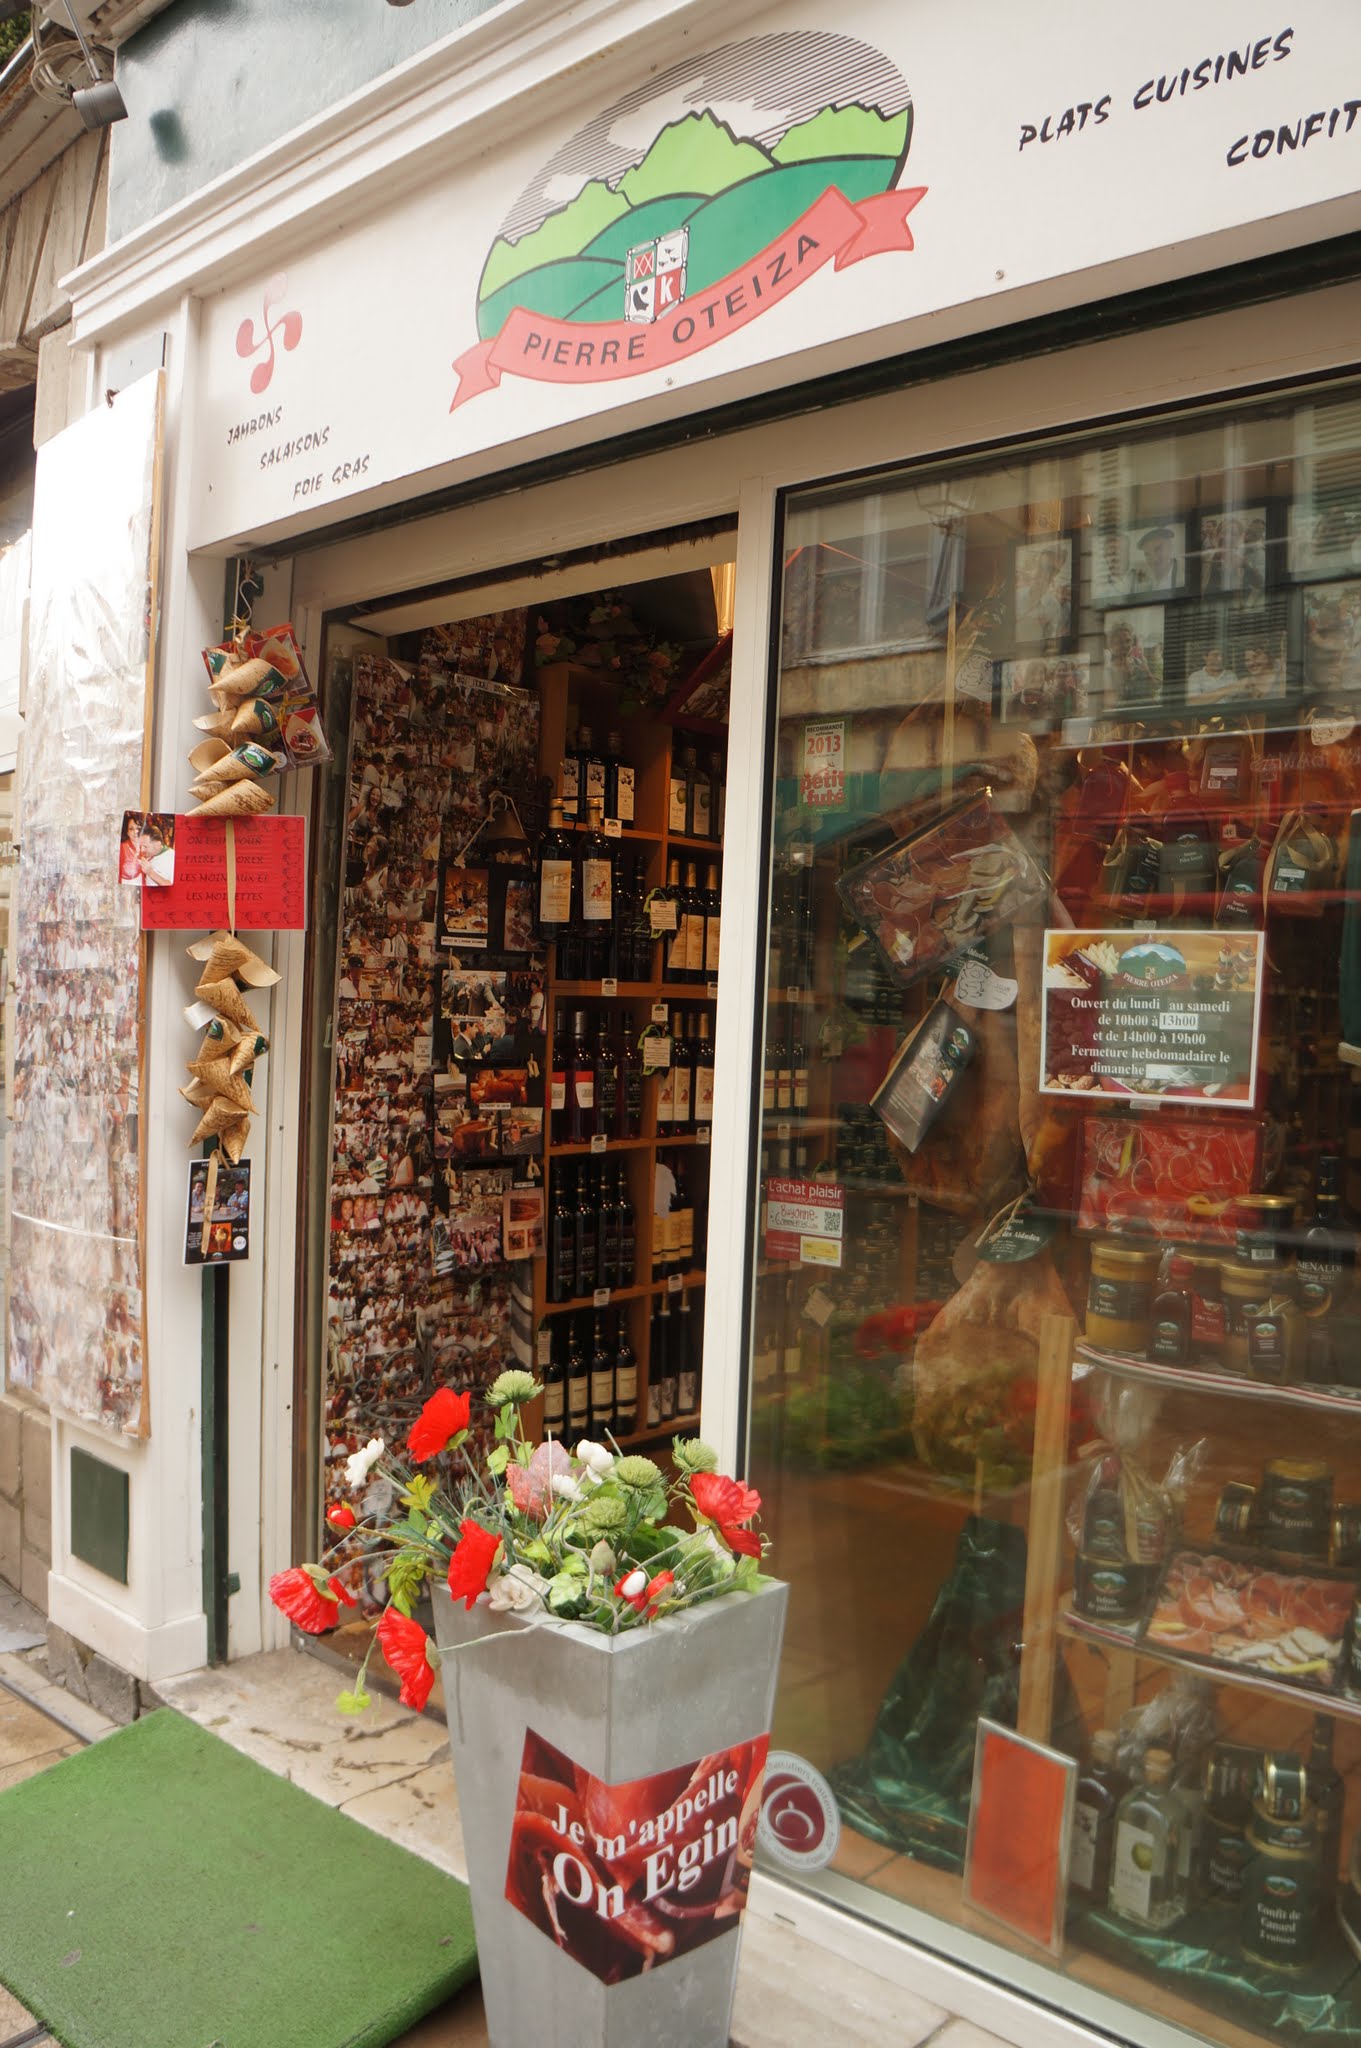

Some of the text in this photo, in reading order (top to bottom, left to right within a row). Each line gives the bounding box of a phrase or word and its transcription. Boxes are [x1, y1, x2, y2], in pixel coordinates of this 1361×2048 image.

[1019, 27, 1295, 152] PLATS CUISINES
[523, 235, 820, 367] PIERRE OTEIZA
[227, 405, 283, 446] JAMBONS
[260, 425, 330, 471] SALAISONS
[293, 454, 370, 501] FOIE GRAS
[807, 735, 841, 755] 2013
[800, 769, 846, 794] petit
[807, 788, 845, 808] futé
[180, 873, 198, 882] LES
[186, 892, 203, 901] LES
[1122, 972, 1179, 988] PIERRE OTEIZA
[1070, 996, 1231, 1013] Ouvert du lundi au samedi
[1097, 1013, 1196, 1027] de 10h00 à 13h00
[1092, 1030, 1206, 1045] et de 14h00 à 19h00
[1071, 1044, 1231, 1063] Fermeture hebdomadaire le
[1090, 1062, 1145, 1076] dimanche
[769, 1180, 842, 1200] L'achat plaisir
[551, 1768, 739, 1861] Je m'appelle
[553, 1815, 738, 1920] On Egin
[1257, 1903, 1287, 1920] Confit
[1260, 1917, 1296, 1933] Canard
